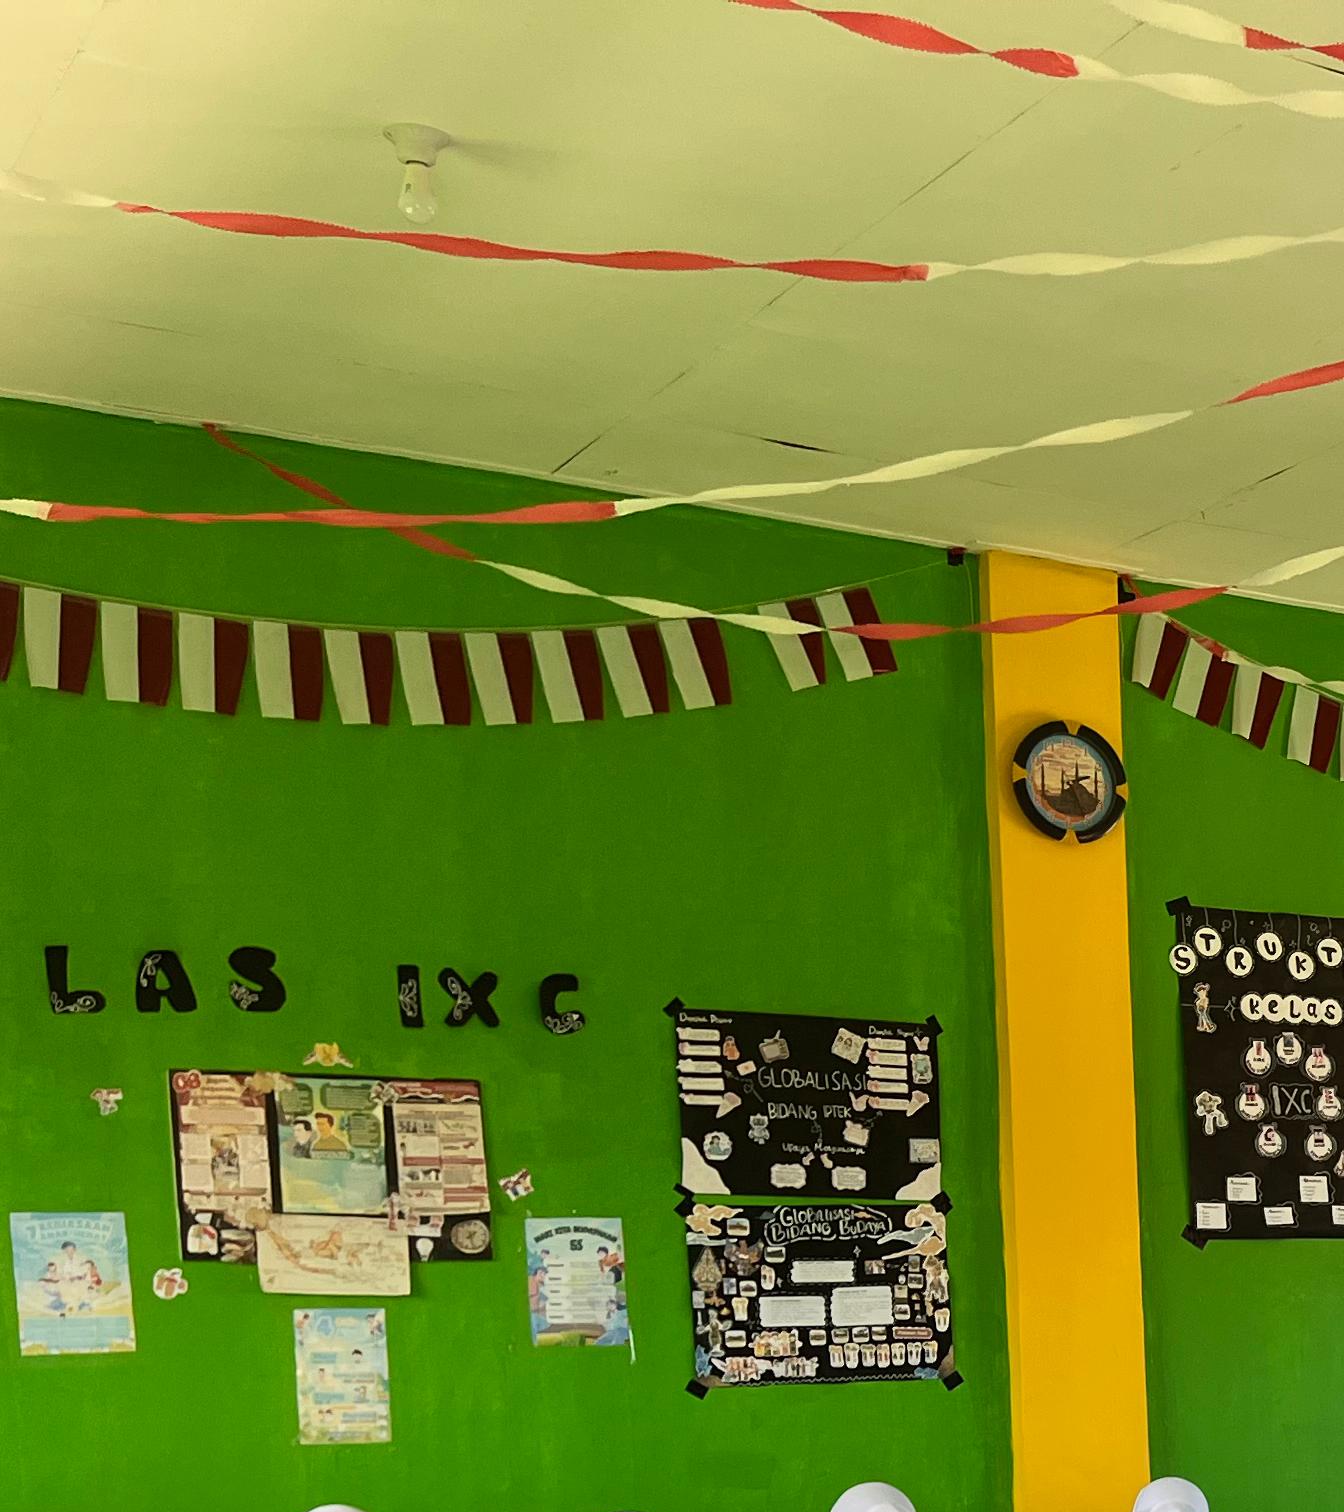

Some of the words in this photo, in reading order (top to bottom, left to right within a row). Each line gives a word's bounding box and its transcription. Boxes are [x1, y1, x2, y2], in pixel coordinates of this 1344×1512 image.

[757, 1066, 868, 1092] GLOBALISASI
[767, 1102, 818, 1120] BIDANG
[822, 1103, 853, 1119] IPTEK
[1271, 1085, 1312, 1115] IXC
